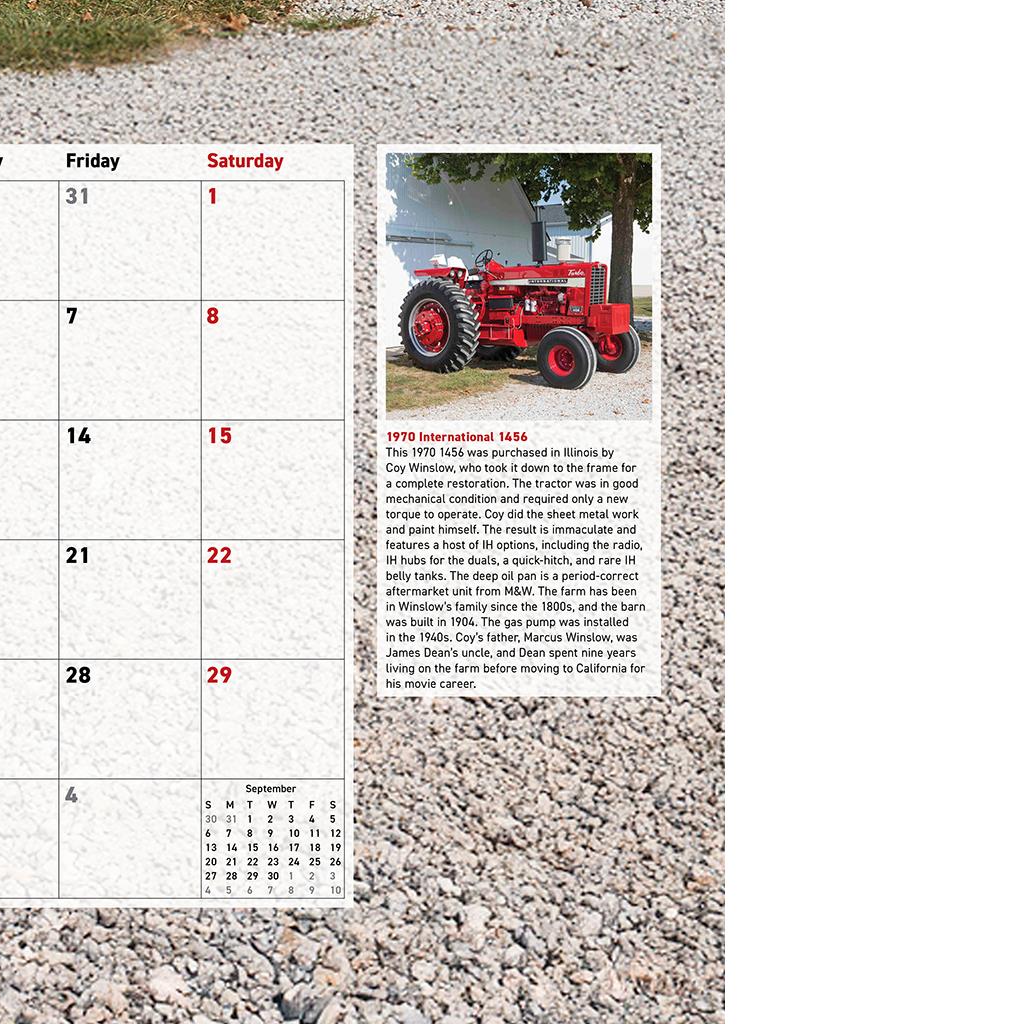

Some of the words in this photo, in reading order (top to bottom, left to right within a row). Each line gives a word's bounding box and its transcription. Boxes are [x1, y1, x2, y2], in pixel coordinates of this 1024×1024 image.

[67, 153, 120, 171] Friday
[208, 153, 283, 171] Saturday
[66, 188, 87, 204] 31
[209, 188, 216, 204] 1
[67, 307, 77, 324] 7
[207, 307, 219, 324] 8
[68, 427, 91, 443] 14
[209, 427, 231, 444] 15
[386, 431, 416, 442] 1970
[419, 431, 495, 442] International
[498, 431, 528, 442] 1456
[385, 446, 409, 458] This
[412, 446, 436, 458] 1970
[440, 446, 465, 458] 1456
[466, 449, 489, 458] was
[491, 447, 548, 460] purchased
[550, 447, 561, 458] in
[563, 447, 599, 458] Illinois
[601, 447, 615, 460] by
[385, 462, 407, 475] Coy
[408, 462, 457, 474] Winslow,
[458, 462, 482, 473] who
[484, 462, 508, 473] took
[510, 462, 518, 473] it
[520, 462, 550, 473] down
[552, 463, 564, 473] to
[566, 462, 584, 473] the
[586, 462, 619, 473] frame
[621, 462, 637, 473] for
[385, 493, 446, 504] mechanical
[448, 493, 497, 504] condition
[499, 493, 520, 504] and
[523, 493, 569, 506] required
[571, 493, 595, 506] only
[596, 495, 604, 504] a
[606, 495, 629, 504] new
[385, 539, 431, 550] features
[432, 541, 440, 550] a
[442, 539, 466, 550] host
[468, 539, 480, 550] of
[482, 539, 494, 550] IH
[496, 539, 539, 552] options,
[541, 539, 590, 553] including
[592, 539, 610, 550] the
[612, 539, 643, 552] radio,
[66, 547, 87, 563] 21
[208, 547, 231, 563] 22
[385, 570, 412, 583] belly
[414, 570, 447, 581] tanks.
[449, 570, 470, 581] The
[472, 570, 499, 583] deep
[501, 570, 515, 581] oil
[517, 572, 537, 583] pan
[540, 570, 550, 581] is
[552, 572, 559, 581] a
[561, 570, 639, 583] period-correct
[385, 618, 408, 627] was
[410, 616, 434, 627] built
[437, 616, 447, 627] in
[450, 616, 478, 627] 1904.
[480, 616, 501, 627] The
[503, 618, 523, 630] gas
[525, 618, 556, 630] pump
[558, 618, 581, 627] was
[583, 616, 629, 627] installed
[66, 666, 90, 683] 28
[207, 666, 232, 683] 29
[385, 663, 415, 676] living
[417, 665, 432, 674] on
[434, 663, 452, 674] the
[454, 662, 480, 674] farm
[483, 662, 518, 674] before
[520, 663, 560, 676] moving
[562, 664, 574, 674] to
[576, 662, 627, 674] California
[629, 662, 646, 674] for
[65, 787, 78, 802] 4
[246, 784, 296, 794] September
[206, 843, 217, 851] 13
[227, 843, 237, 851] 14
[248, 843, 258, 851] 15
[269, 843, 279, 851] 16
[289, 843, 299, 851] 17
[310, 843, 320, 851] 18
[331, 843, 341, 851] 19
